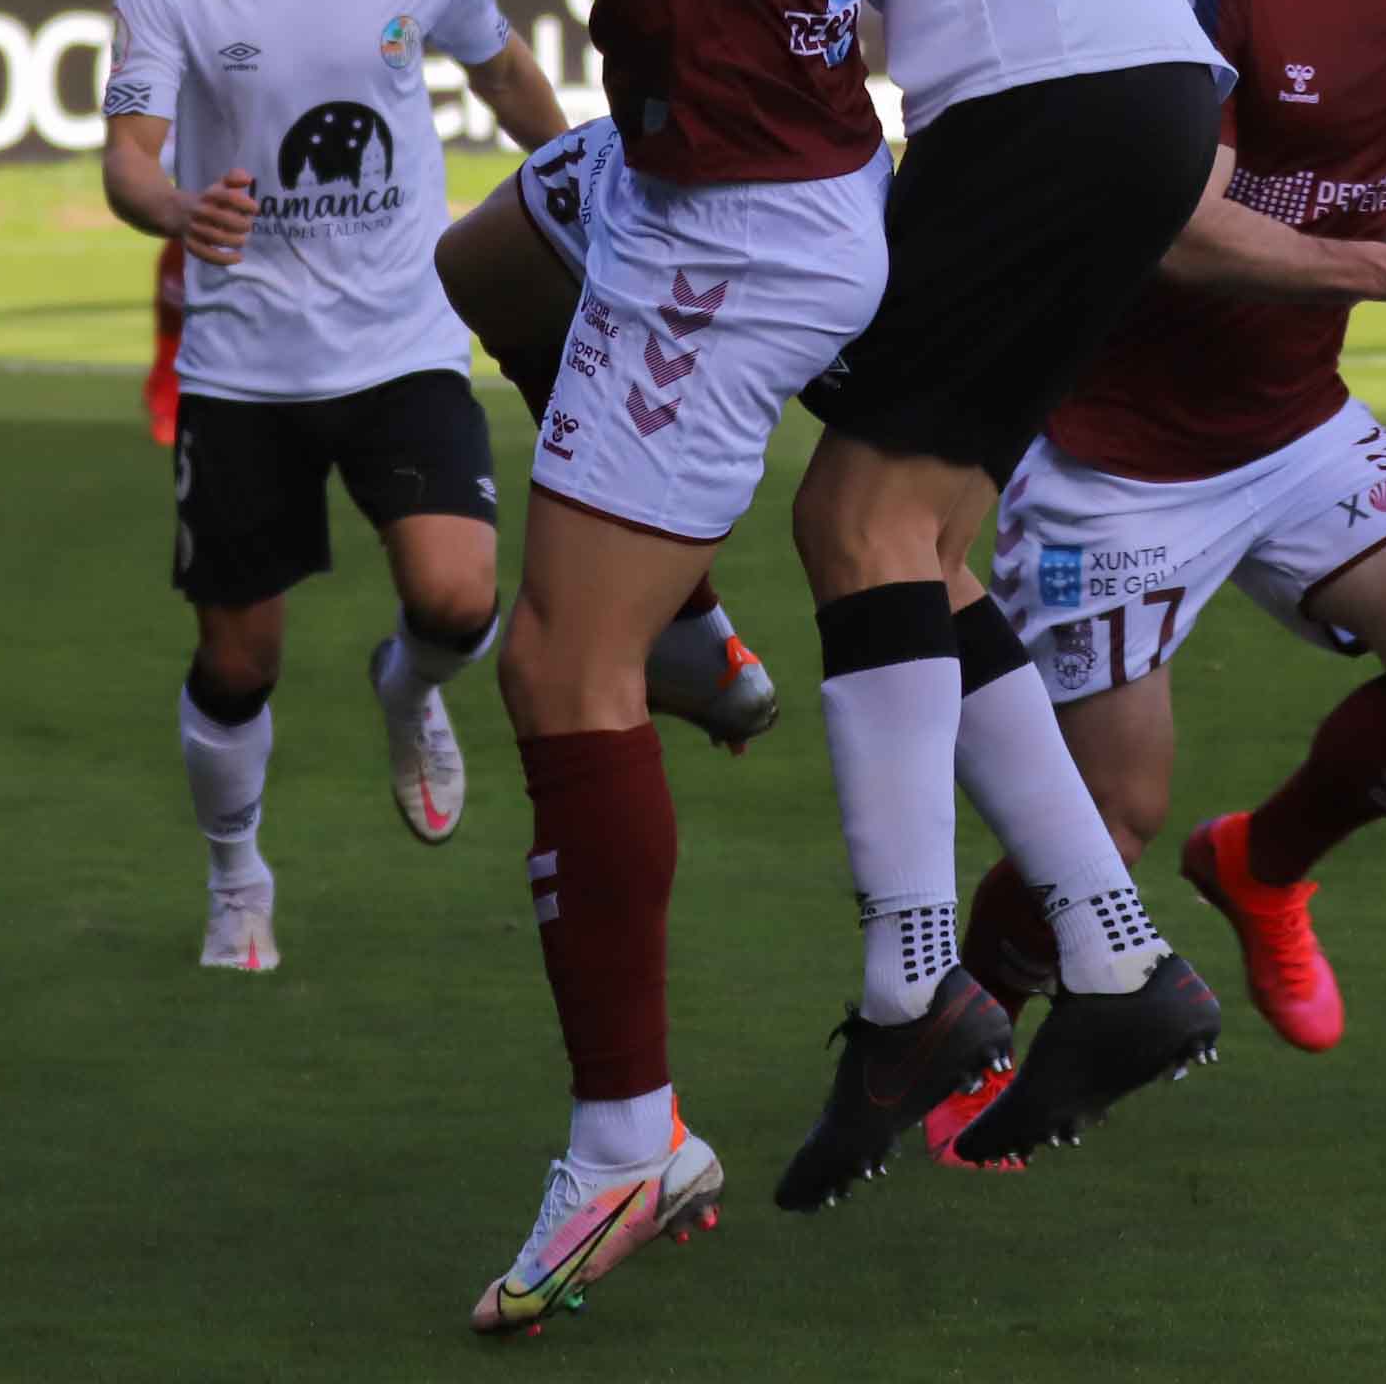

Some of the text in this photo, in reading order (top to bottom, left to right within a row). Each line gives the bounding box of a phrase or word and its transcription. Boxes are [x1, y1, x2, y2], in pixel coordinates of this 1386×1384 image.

[1090, 545, 1167, 571] XUNTA
[1089, 577, 1118, 597] DE
[1097, 586, 1187, 690] 17
